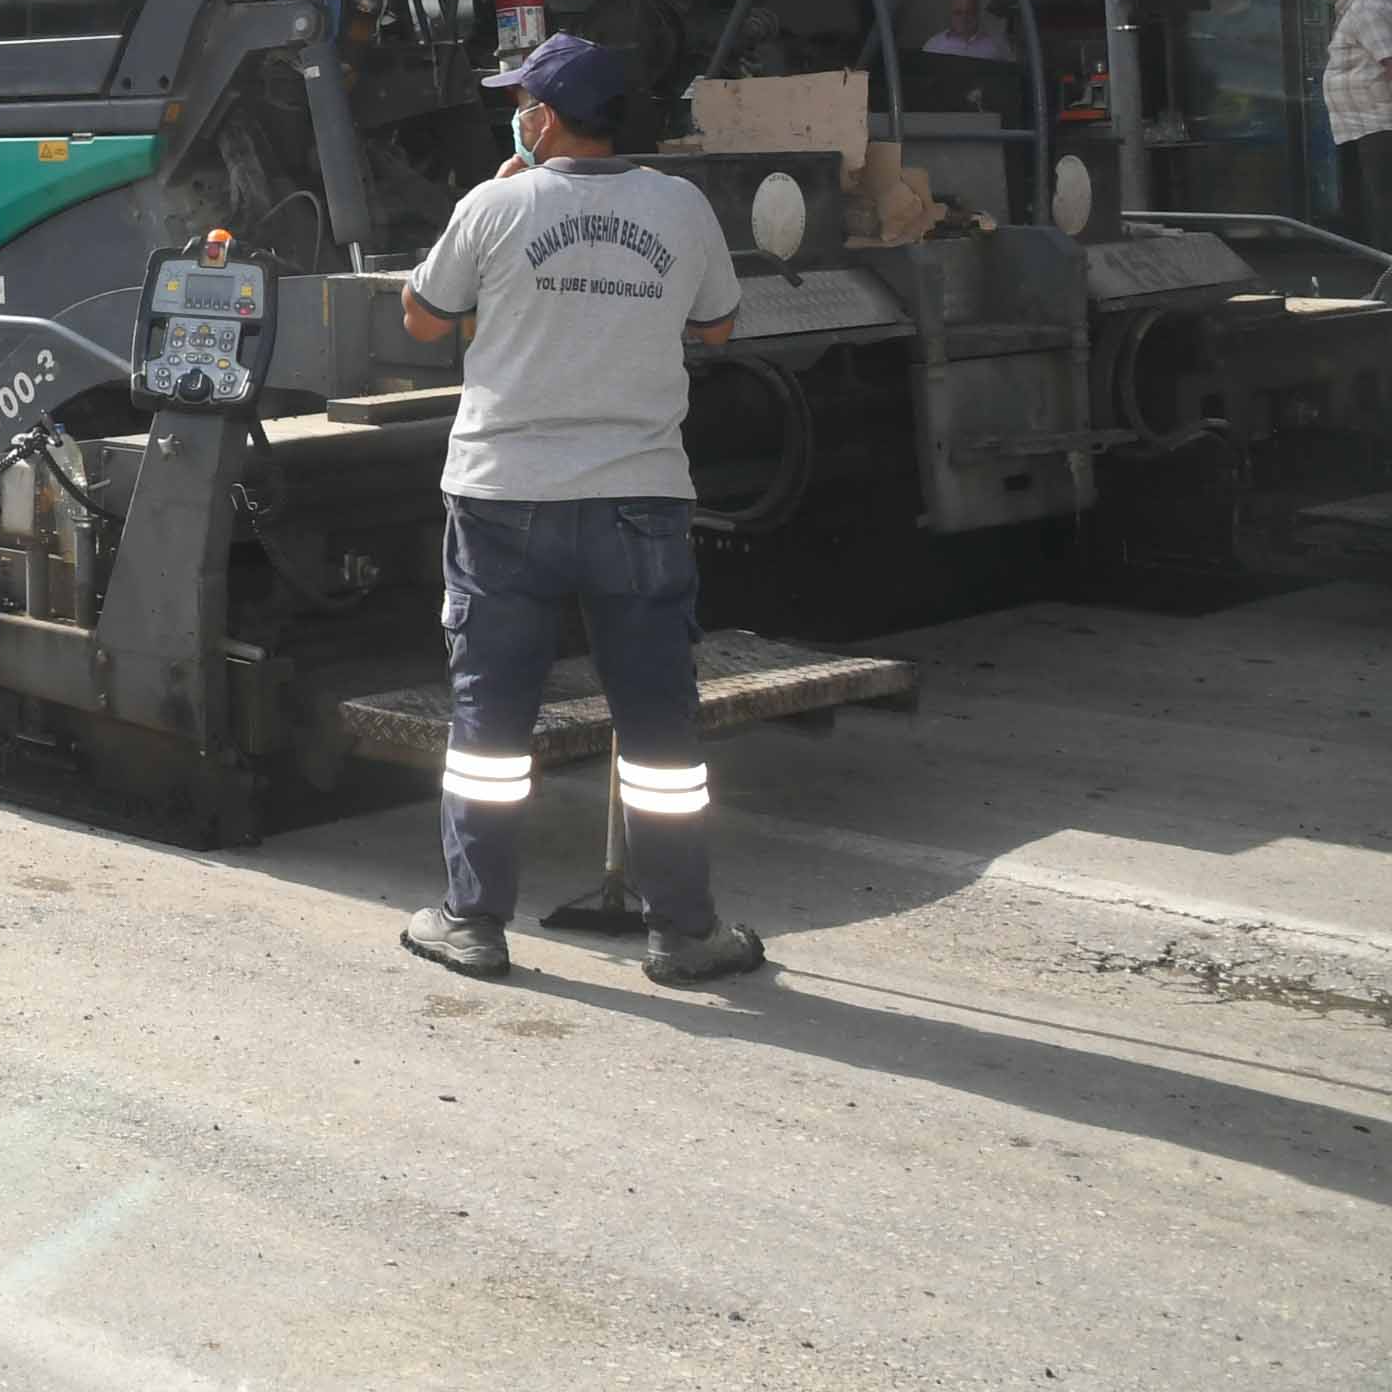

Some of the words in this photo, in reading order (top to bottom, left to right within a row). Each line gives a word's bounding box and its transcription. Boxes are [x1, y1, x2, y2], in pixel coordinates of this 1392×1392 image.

[524, 226, 563, 270] ADANA
[560, 209, 620, 248] BÜYÜKŞEHİR
[620, 220, 678, 278] BELEDİYESİ
[535, 276, 557, 291] YOL
[560, 277, 587, 294] ŞUBE
[590, 277, 664, 298] MÜDÜRLÜĞÜ
